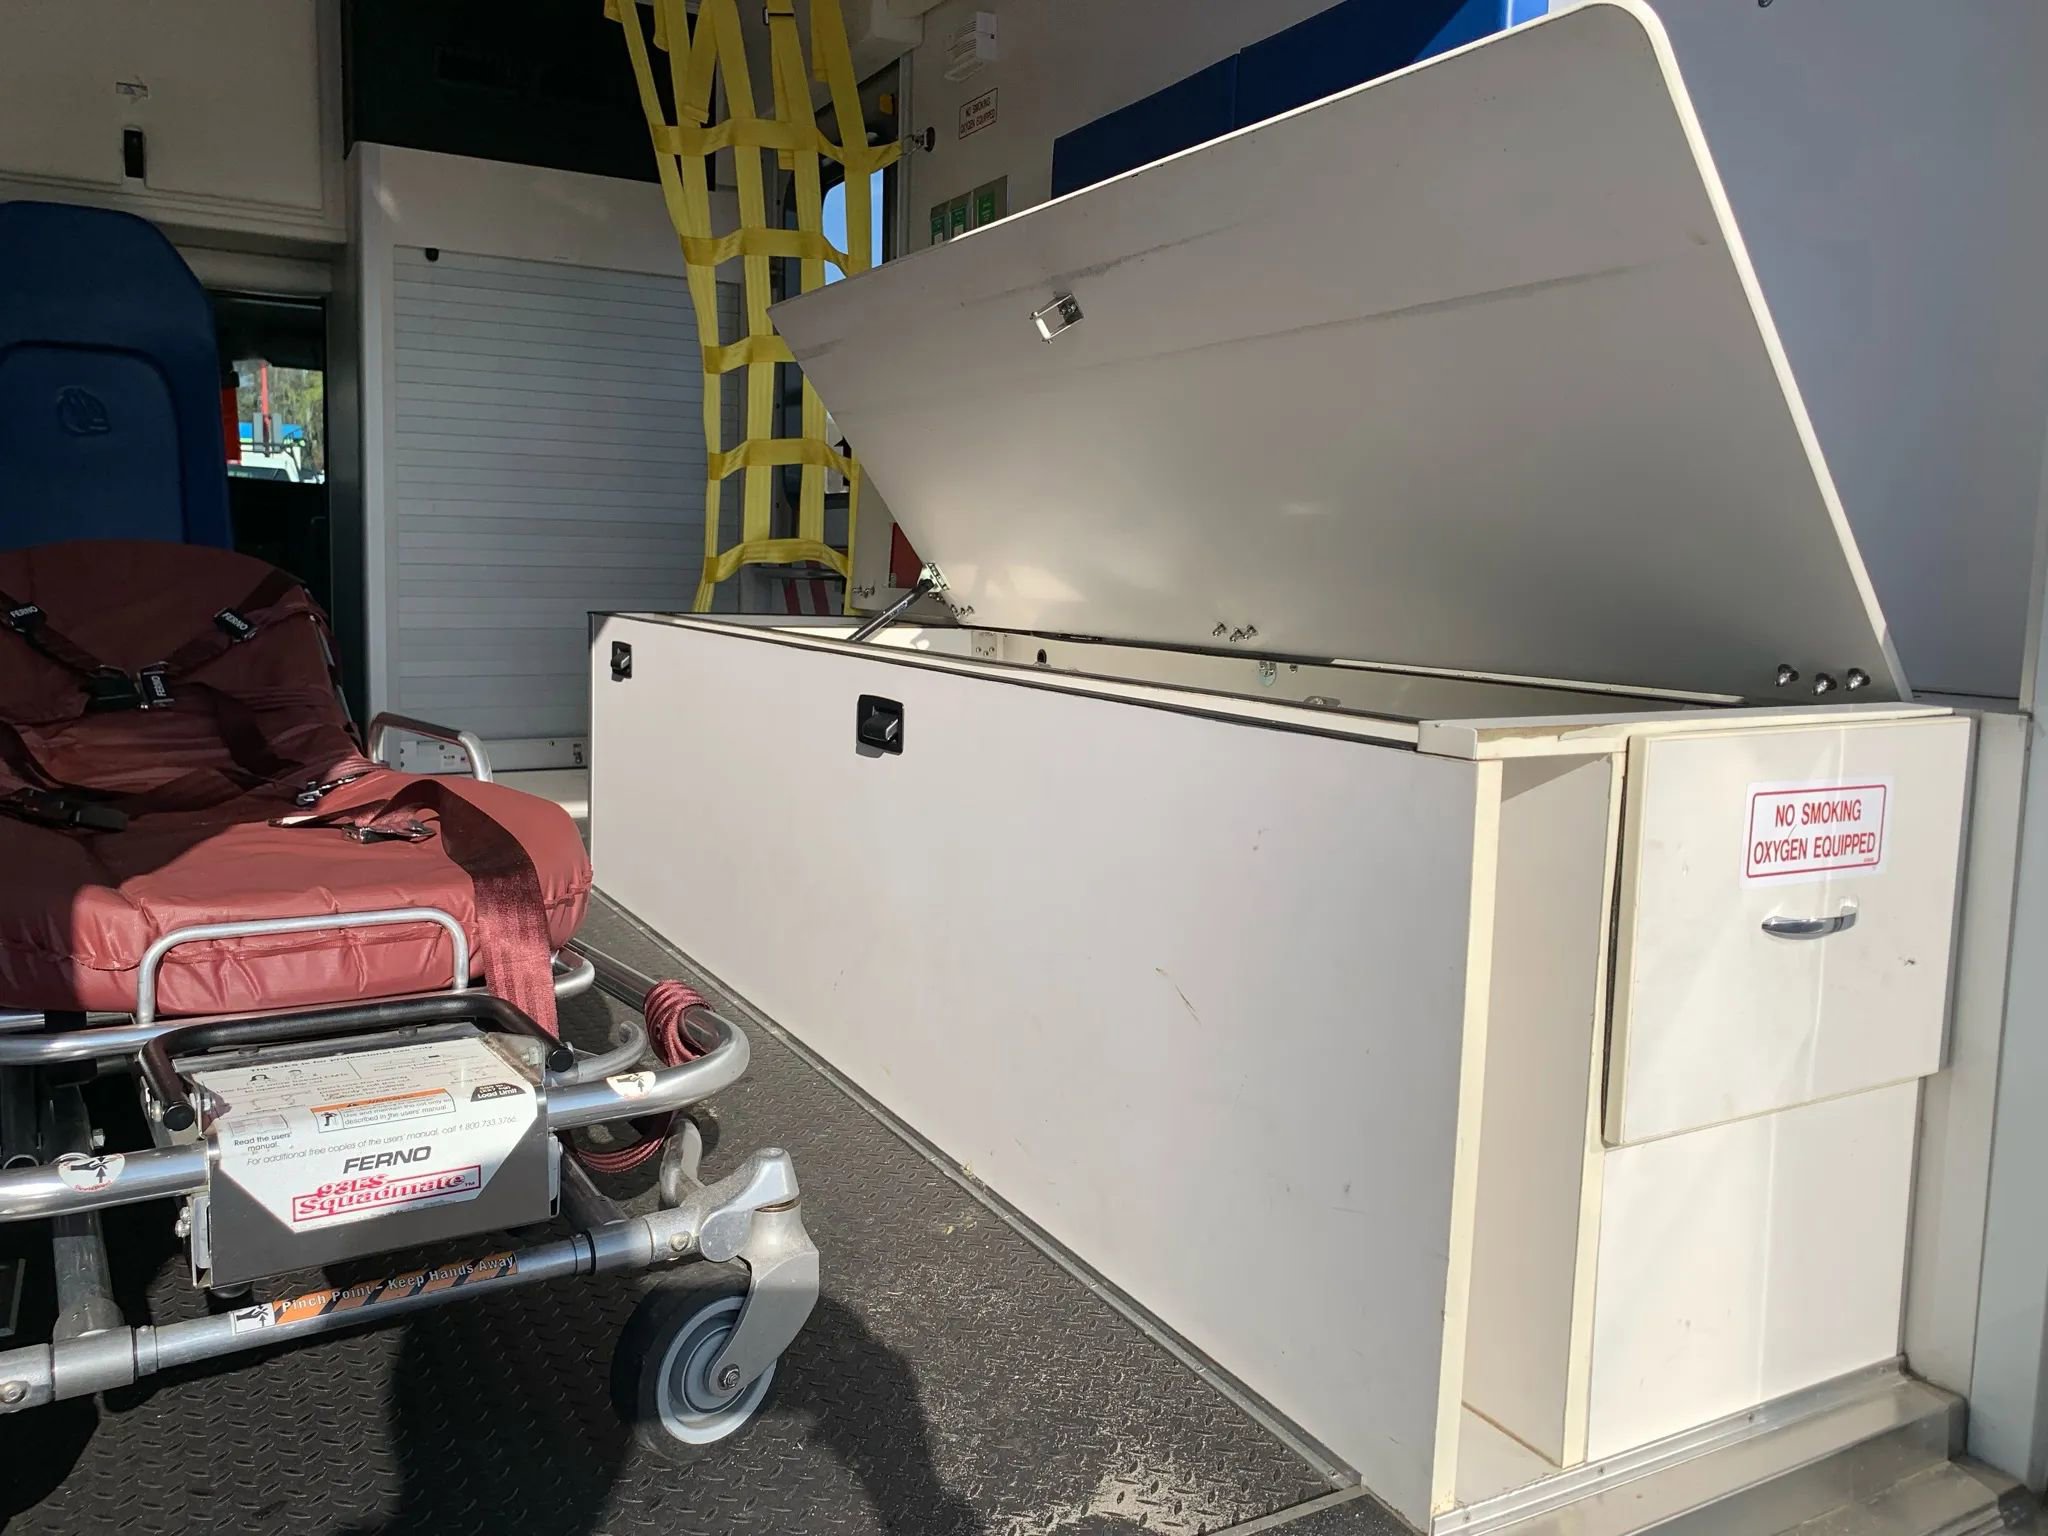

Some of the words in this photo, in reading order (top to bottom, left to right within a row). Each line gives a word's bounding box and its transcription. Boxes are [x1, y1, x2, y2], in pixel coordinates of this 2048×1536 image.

[10, 605, 38, 618] FERNO
[221, 611, 249, 631] FERNO
[150, 675, 168, 697] FERNO
[1775, 803, 1796, 828] NO
[1800, 799, 1862, 826] SMOKING
[1753, 836, 1809, 865] OXYGEN
[1813, 831, 1876, 859] EQUIPPED
[476, 1091, 498, 1099] Load
[498, 1088, 518, 1096] Limit
[343, 1113, 378, 1125] described
[234, 1137, 256, 1147] Read
[256, 1135, 270, 1144] the
[246, 1157, 261, 1166] For
[263, 1150, 307, 1164] additional
[308, 1147, 326, 1156] free
[327, 1143, 356, 1154] copies
[357, 1139, 367, 1149] of
[368, 1137, 382, 1146] the
[441, 1125, 457, 1134] call
[342, 1145, 432, 1174] FERNO
[281, 1294, 327, 1313] Pinch
[331, 1285, 372, 1302] Point
[387, 1274, 425, 1291] Keep
[428, 1264, 474, 1282] Hands
[478, 1254, 515, 1272] Away
